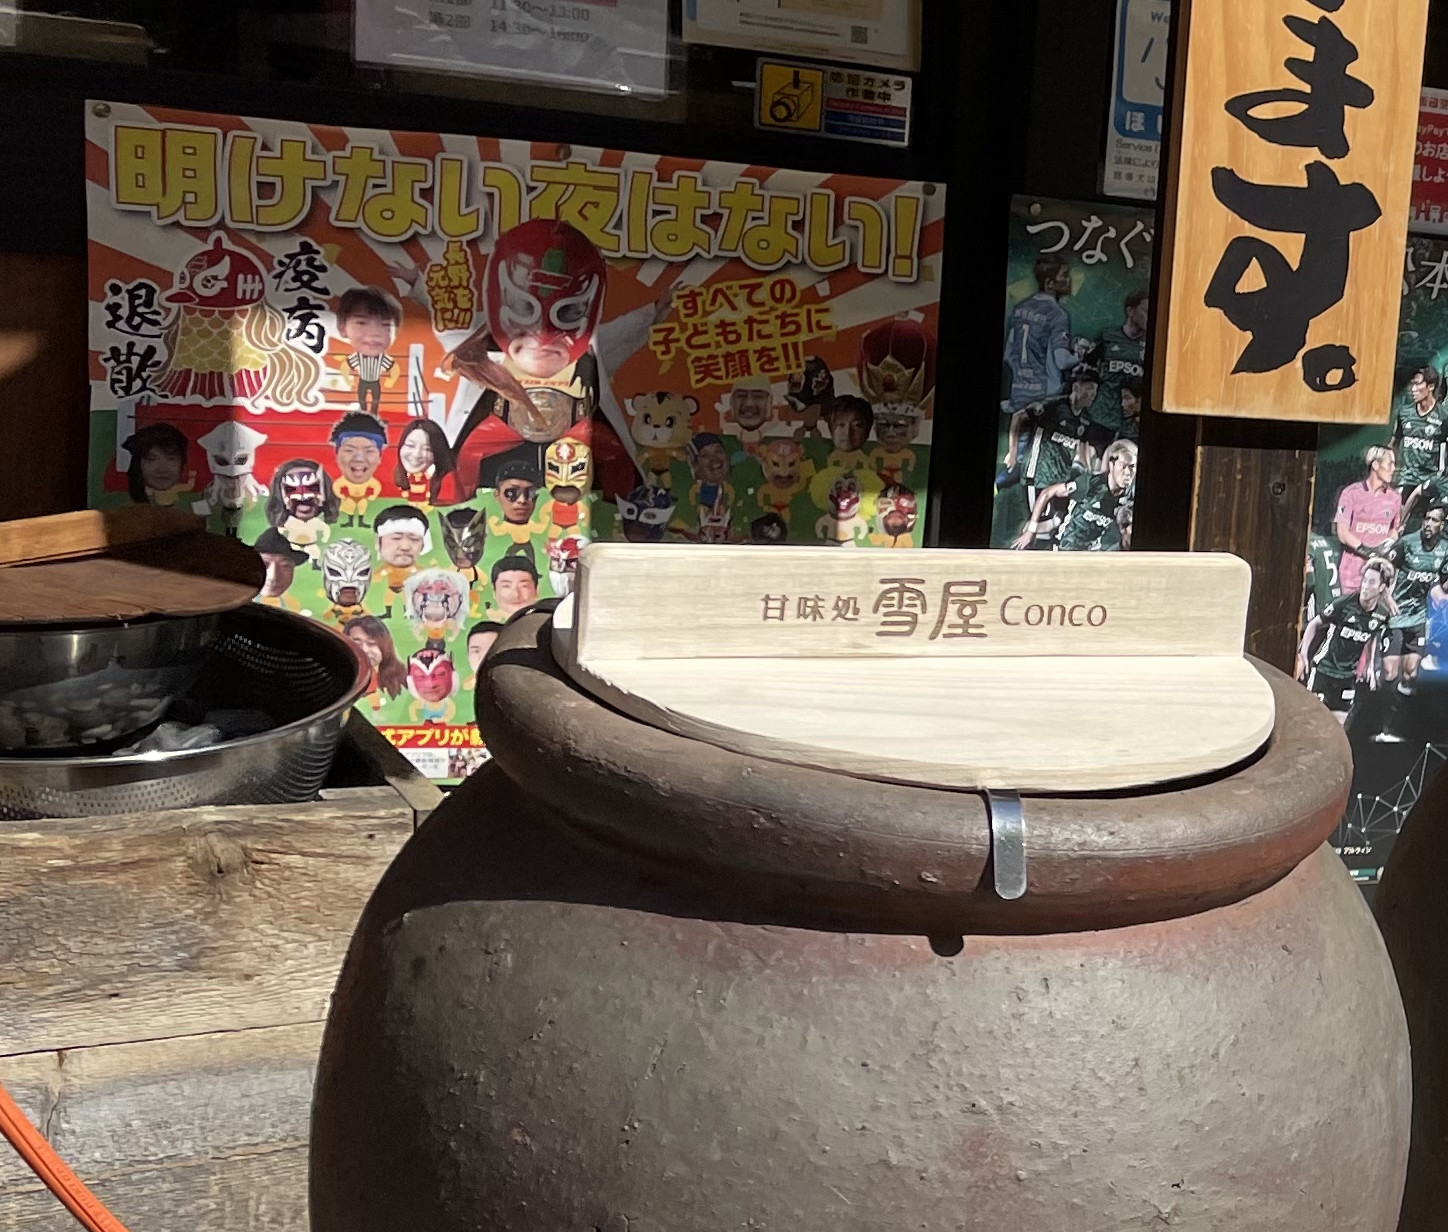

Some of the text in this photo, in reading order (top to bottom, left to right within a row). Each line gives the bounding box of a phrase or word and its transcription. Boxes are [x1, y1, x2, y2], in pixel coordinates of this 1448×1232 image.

[1204, 0, 1383, 392] ます。
[1026, 214, 1155, 270] つなぐ
[272, 240, 332, 356] 疫病
[673, 279, 798, 320] すべての
[102, 282, 171, 400] 退散
[652, 307, 834, 355] 子どもたちに
[690, 344, 804, 386] 笑顔を!!
[1355, 522, 1390, 536] EPSON
[760, 592, 861, 622] 甘味処
[998, 594, 1108, 628] Conco
